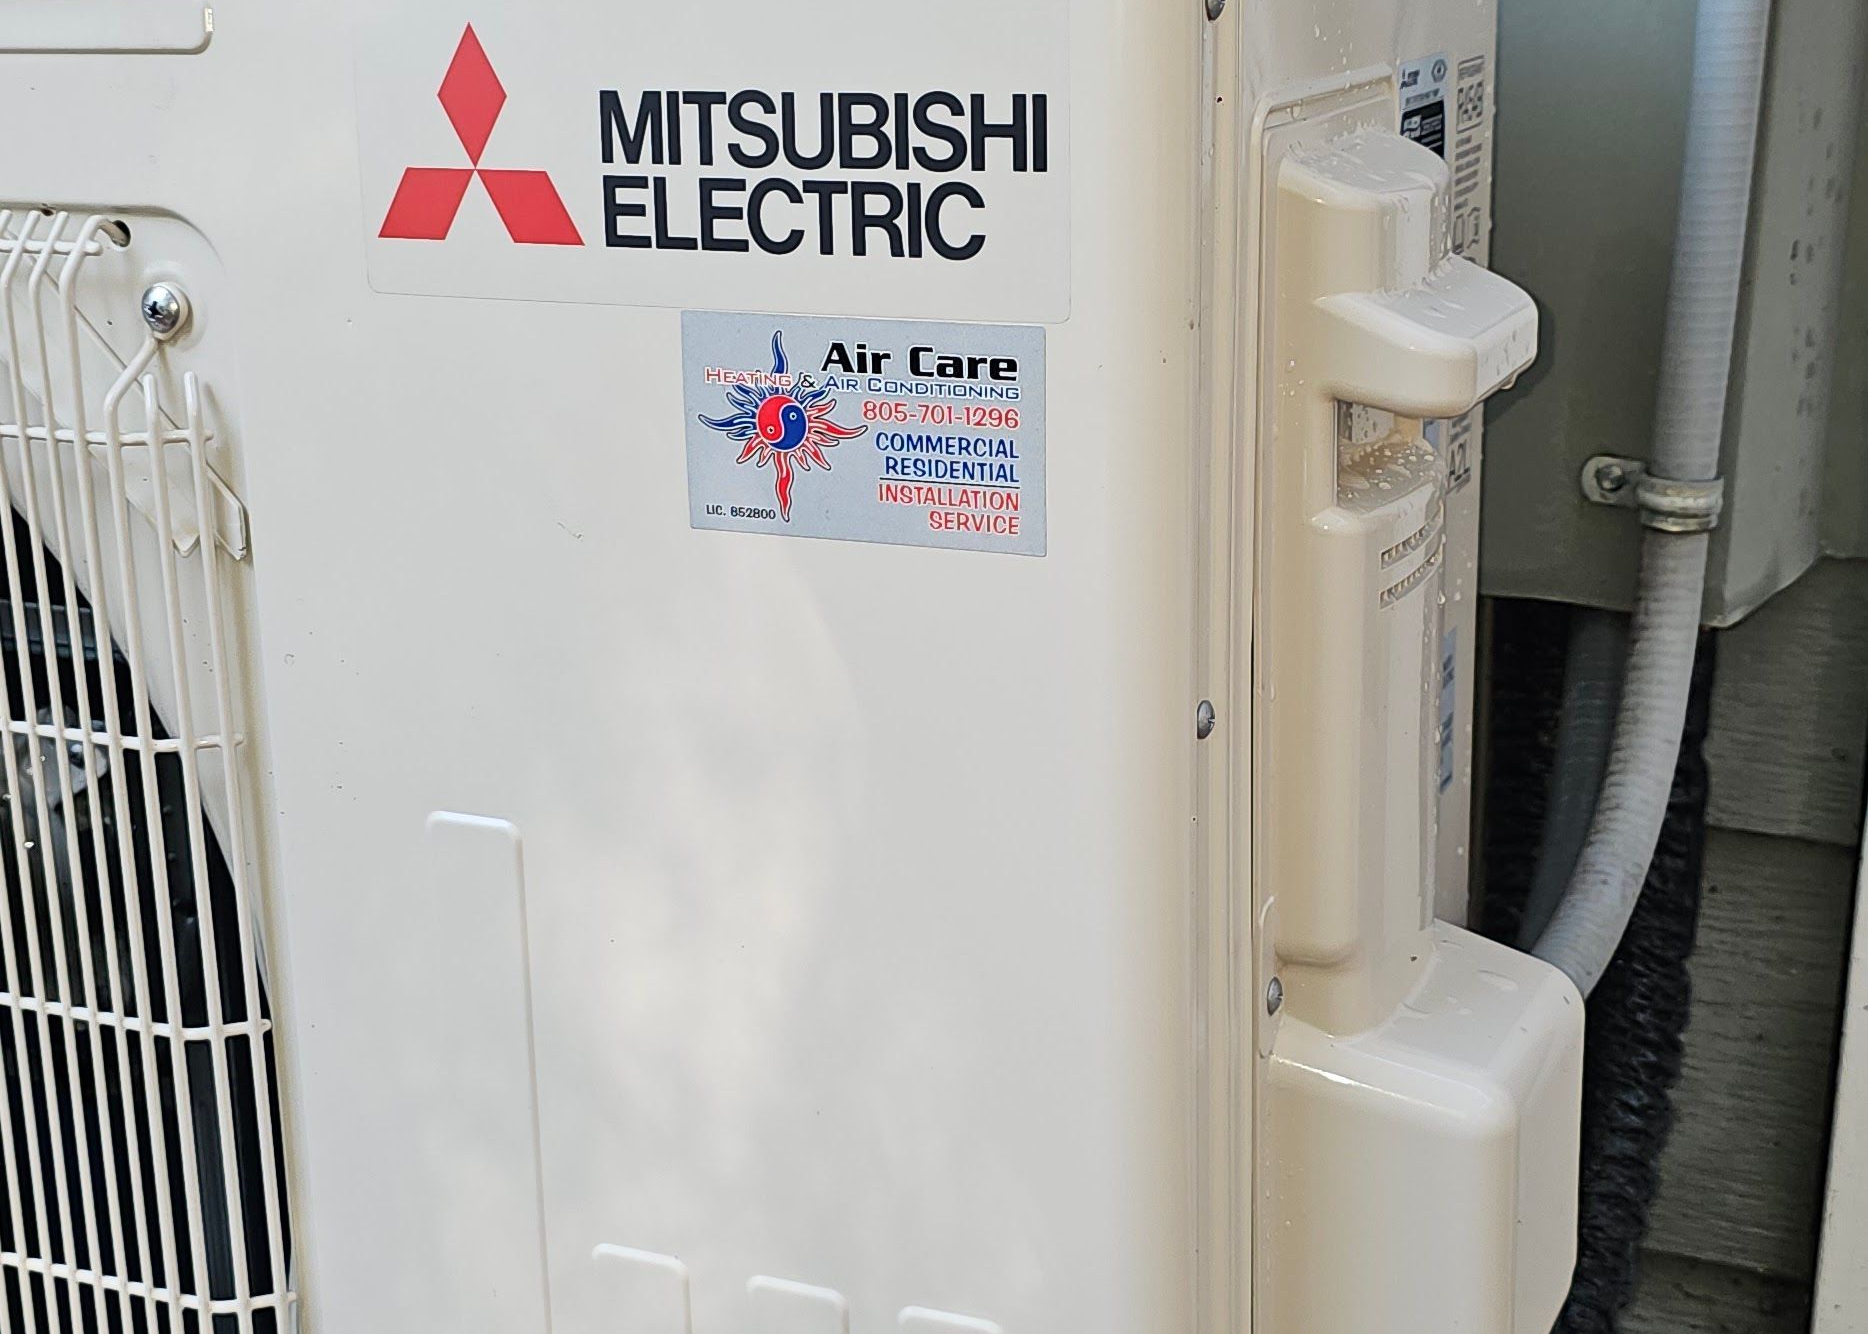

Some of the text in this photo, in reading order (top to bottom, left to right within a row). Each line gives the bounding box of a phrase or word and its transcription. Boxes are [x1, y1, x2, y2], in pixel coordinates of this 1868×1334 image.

[599, 89, 1048, 172] MITSUBISHI
[602, 174, 986, 261] ELECTRIC
[821, 341, 1018, 382] Air Care
[706, 368, 1020, 400] HEATING & AIR CONDITIONING
[863, 400, 1019, 429] 805-701-1296
[876, 432, 1020, 459] COMMERCIAL
[885, 456, 1020, 483] RESIDENTIAL
[878, 483, 1019, 511] INSTALLATION
[706, 504, 776, 520] LIC. 852800
[929, 510, 1020, 535] SERVICE
